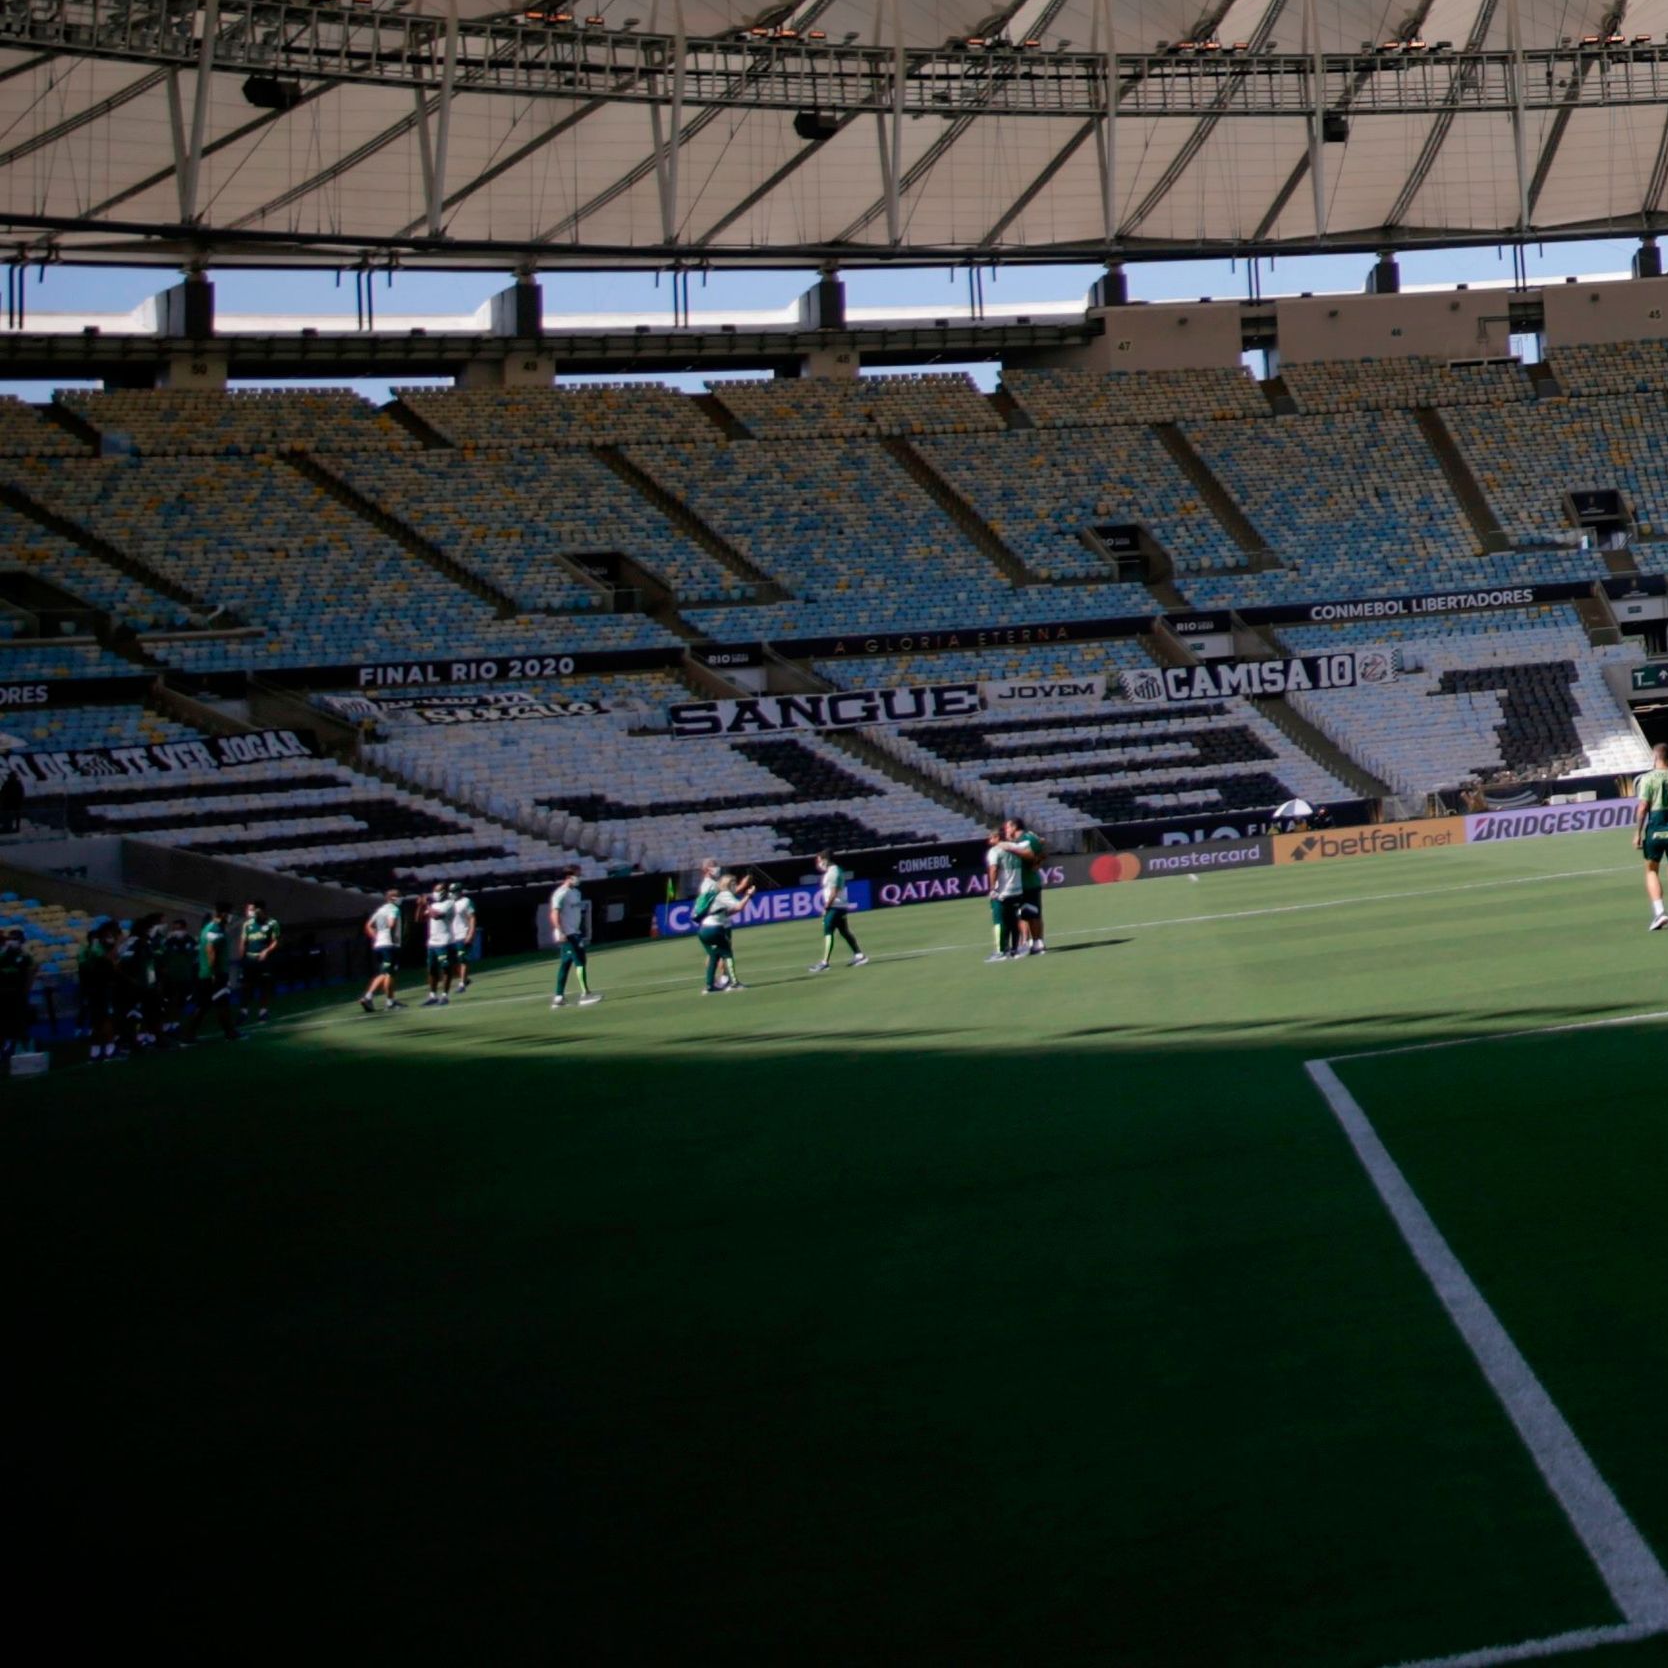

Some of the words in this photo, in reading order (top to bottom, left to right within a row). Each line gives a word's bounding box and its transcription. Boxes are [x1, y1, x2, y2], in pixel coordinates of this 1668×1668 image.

[1649, 310, 1661, 319] 45
[1118, 341, 1131, 351] 47
[1311, 599, 1408, 622] CONMEBOL
[1410, 588, 1534, 614] LIBERTADORES
[978, 626, 1070, 646] ETERNA
[1176, 622, 1196, 632] RIO
[359, 663, 441, 686] FINAL
[452, 660, 498, 682] RIO
[508, 656, 575, 678] 2020
[708, 654, 730, 664] RIO
[998, 682, 1095, 699] JOVEM
[1165, 660, 1314, 700] CAMISA
[1316, 655, 1354, 687] 10
[671, 684, 979, 736] SANGUE
[217, 730, 313, 766] JOGAR
[1149, 844, 1260, 871] mastercard
[880, 877, 960, 906] QATAR
